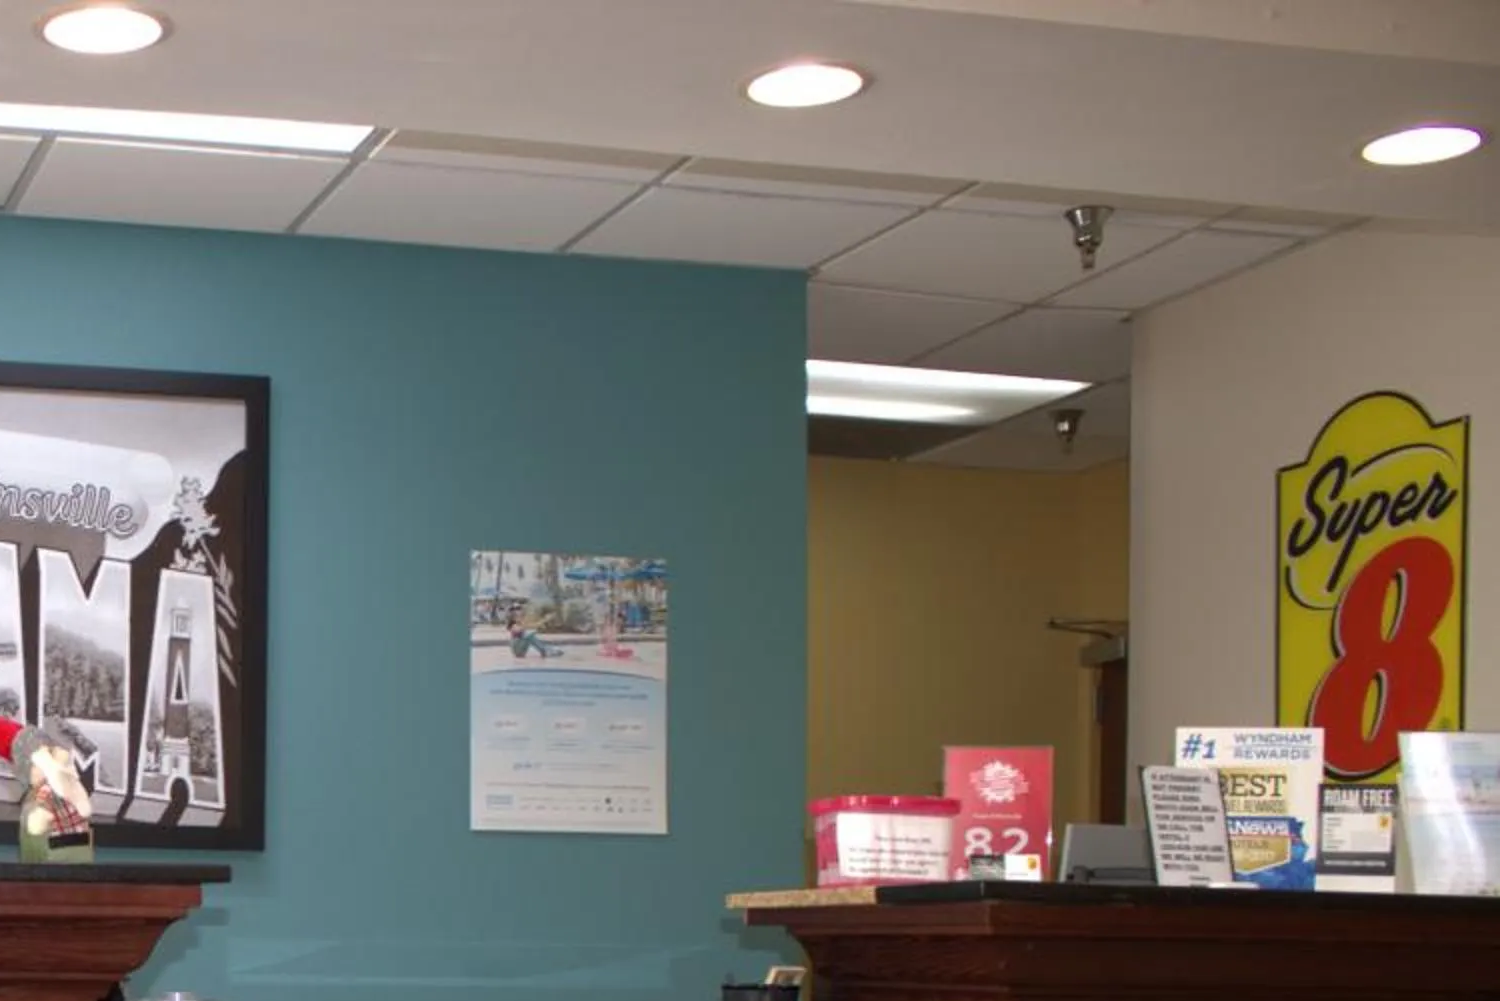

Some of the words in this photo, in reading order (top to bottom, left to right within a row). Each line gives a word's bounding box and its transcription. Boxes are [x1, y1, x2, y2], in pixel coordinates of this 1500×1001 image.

[1287, 455, 1458, 594] Super
[1303, 535, 1455, 782] 8
[1182, 732, 1216, 760] #1
[1233, 732, 1313, 744] WYNDHAM
[1233, 749, 1312, 760] REWARDS
